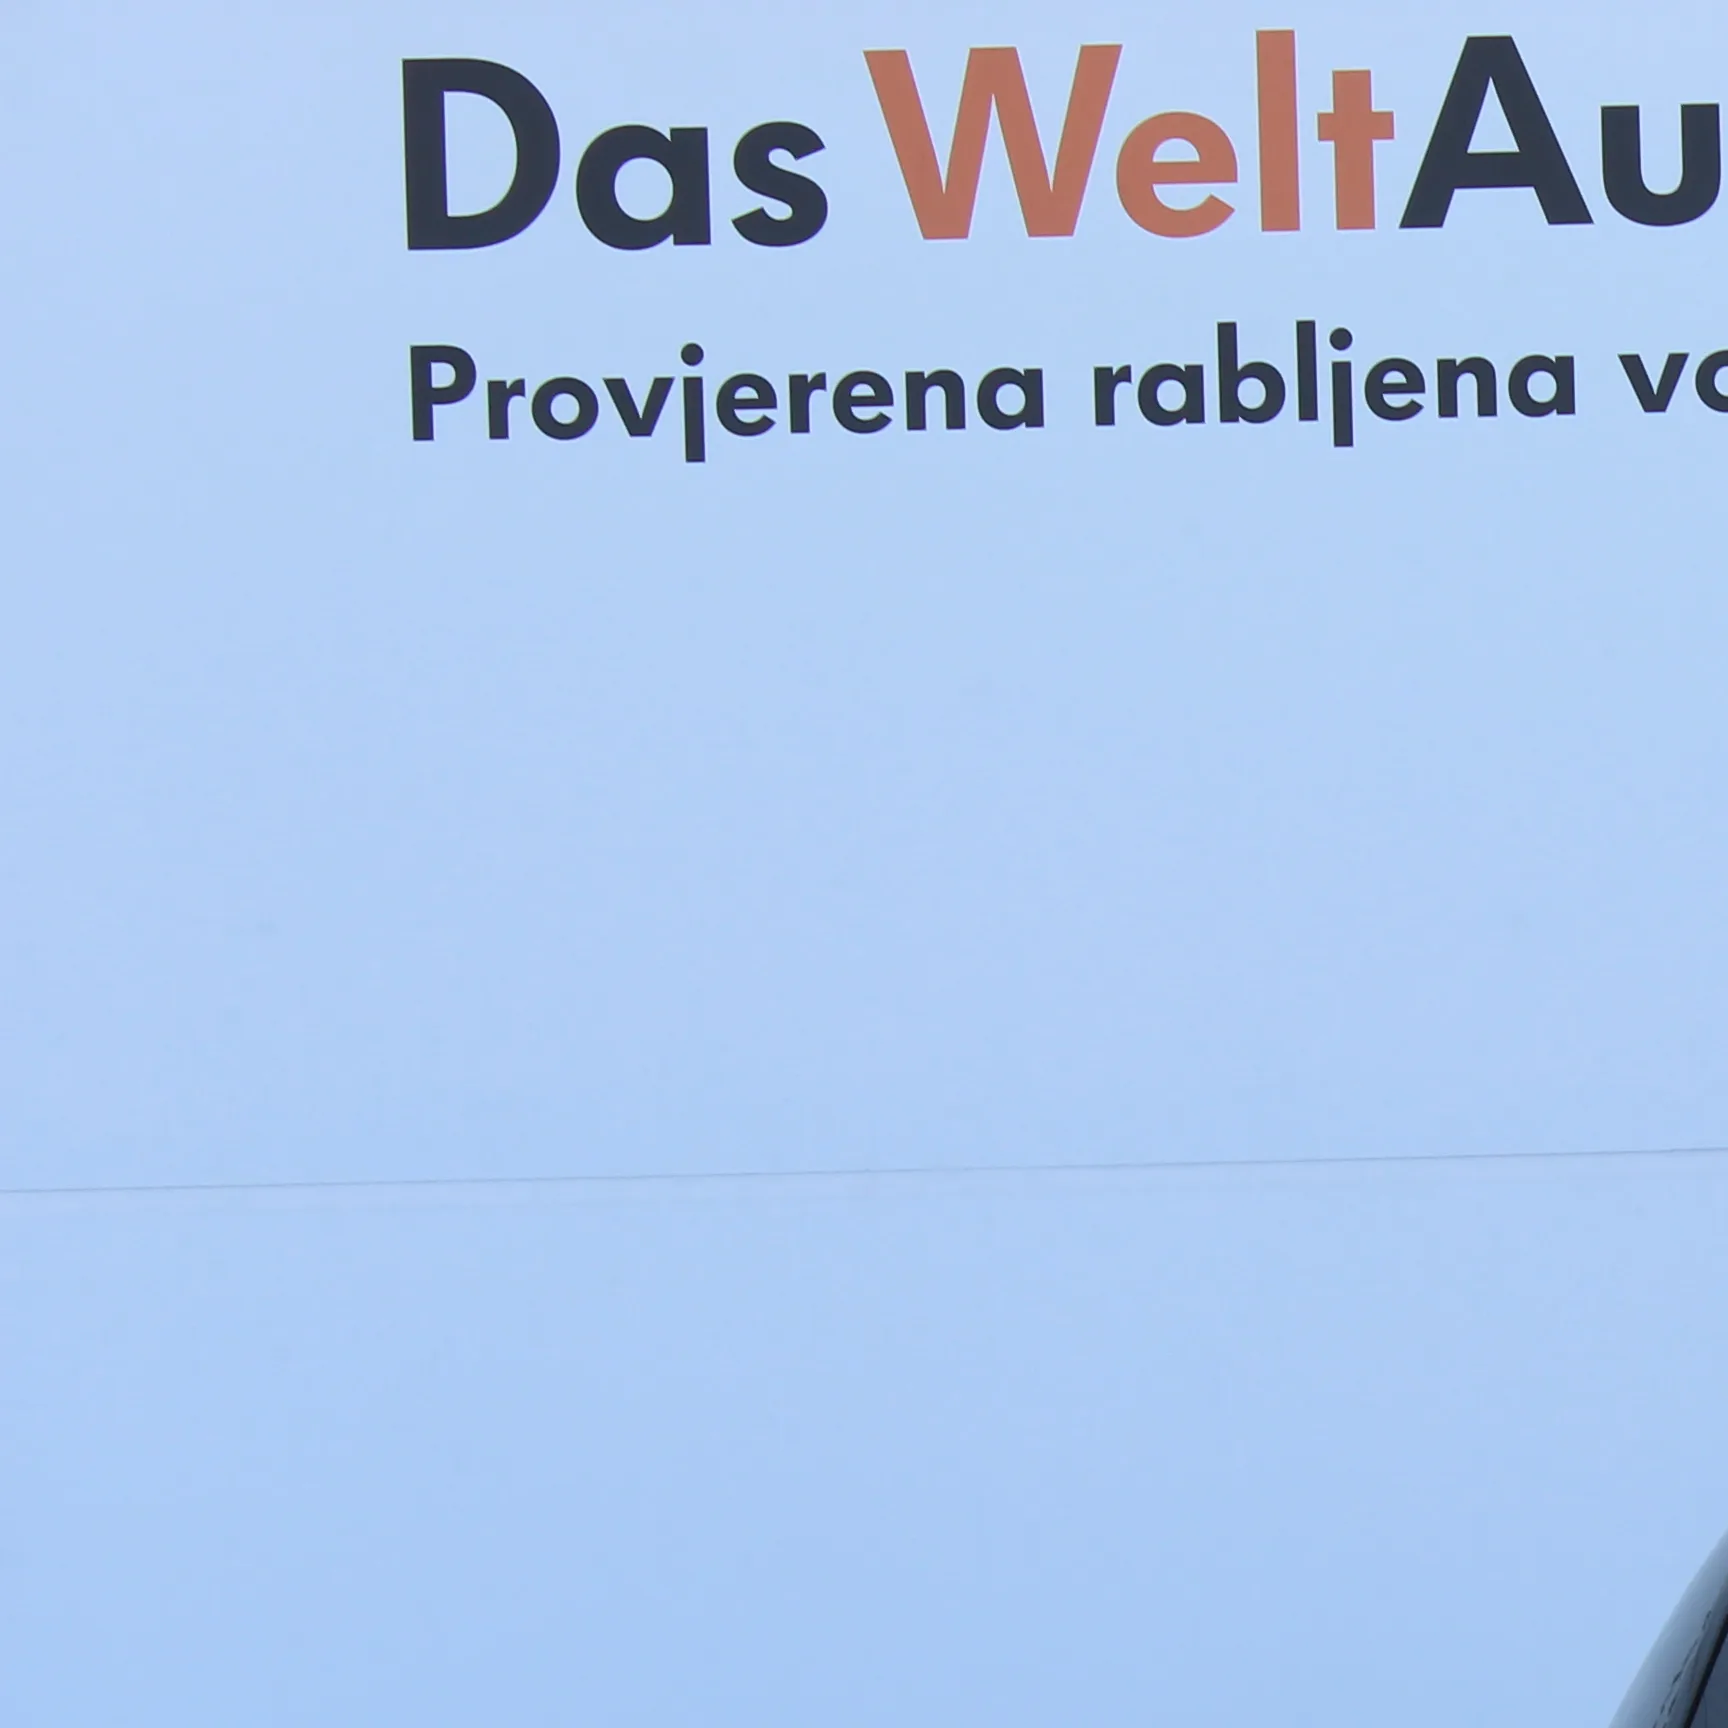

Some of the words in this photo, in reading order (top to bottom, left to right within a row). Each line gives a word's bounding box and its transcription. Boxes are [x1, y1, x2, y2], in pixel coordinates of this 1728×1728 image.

[402, 57, 828, 251] Das
[409, 342, 1045, 463] Provjerena
[1093, 319, 1576, 448] rabljena
